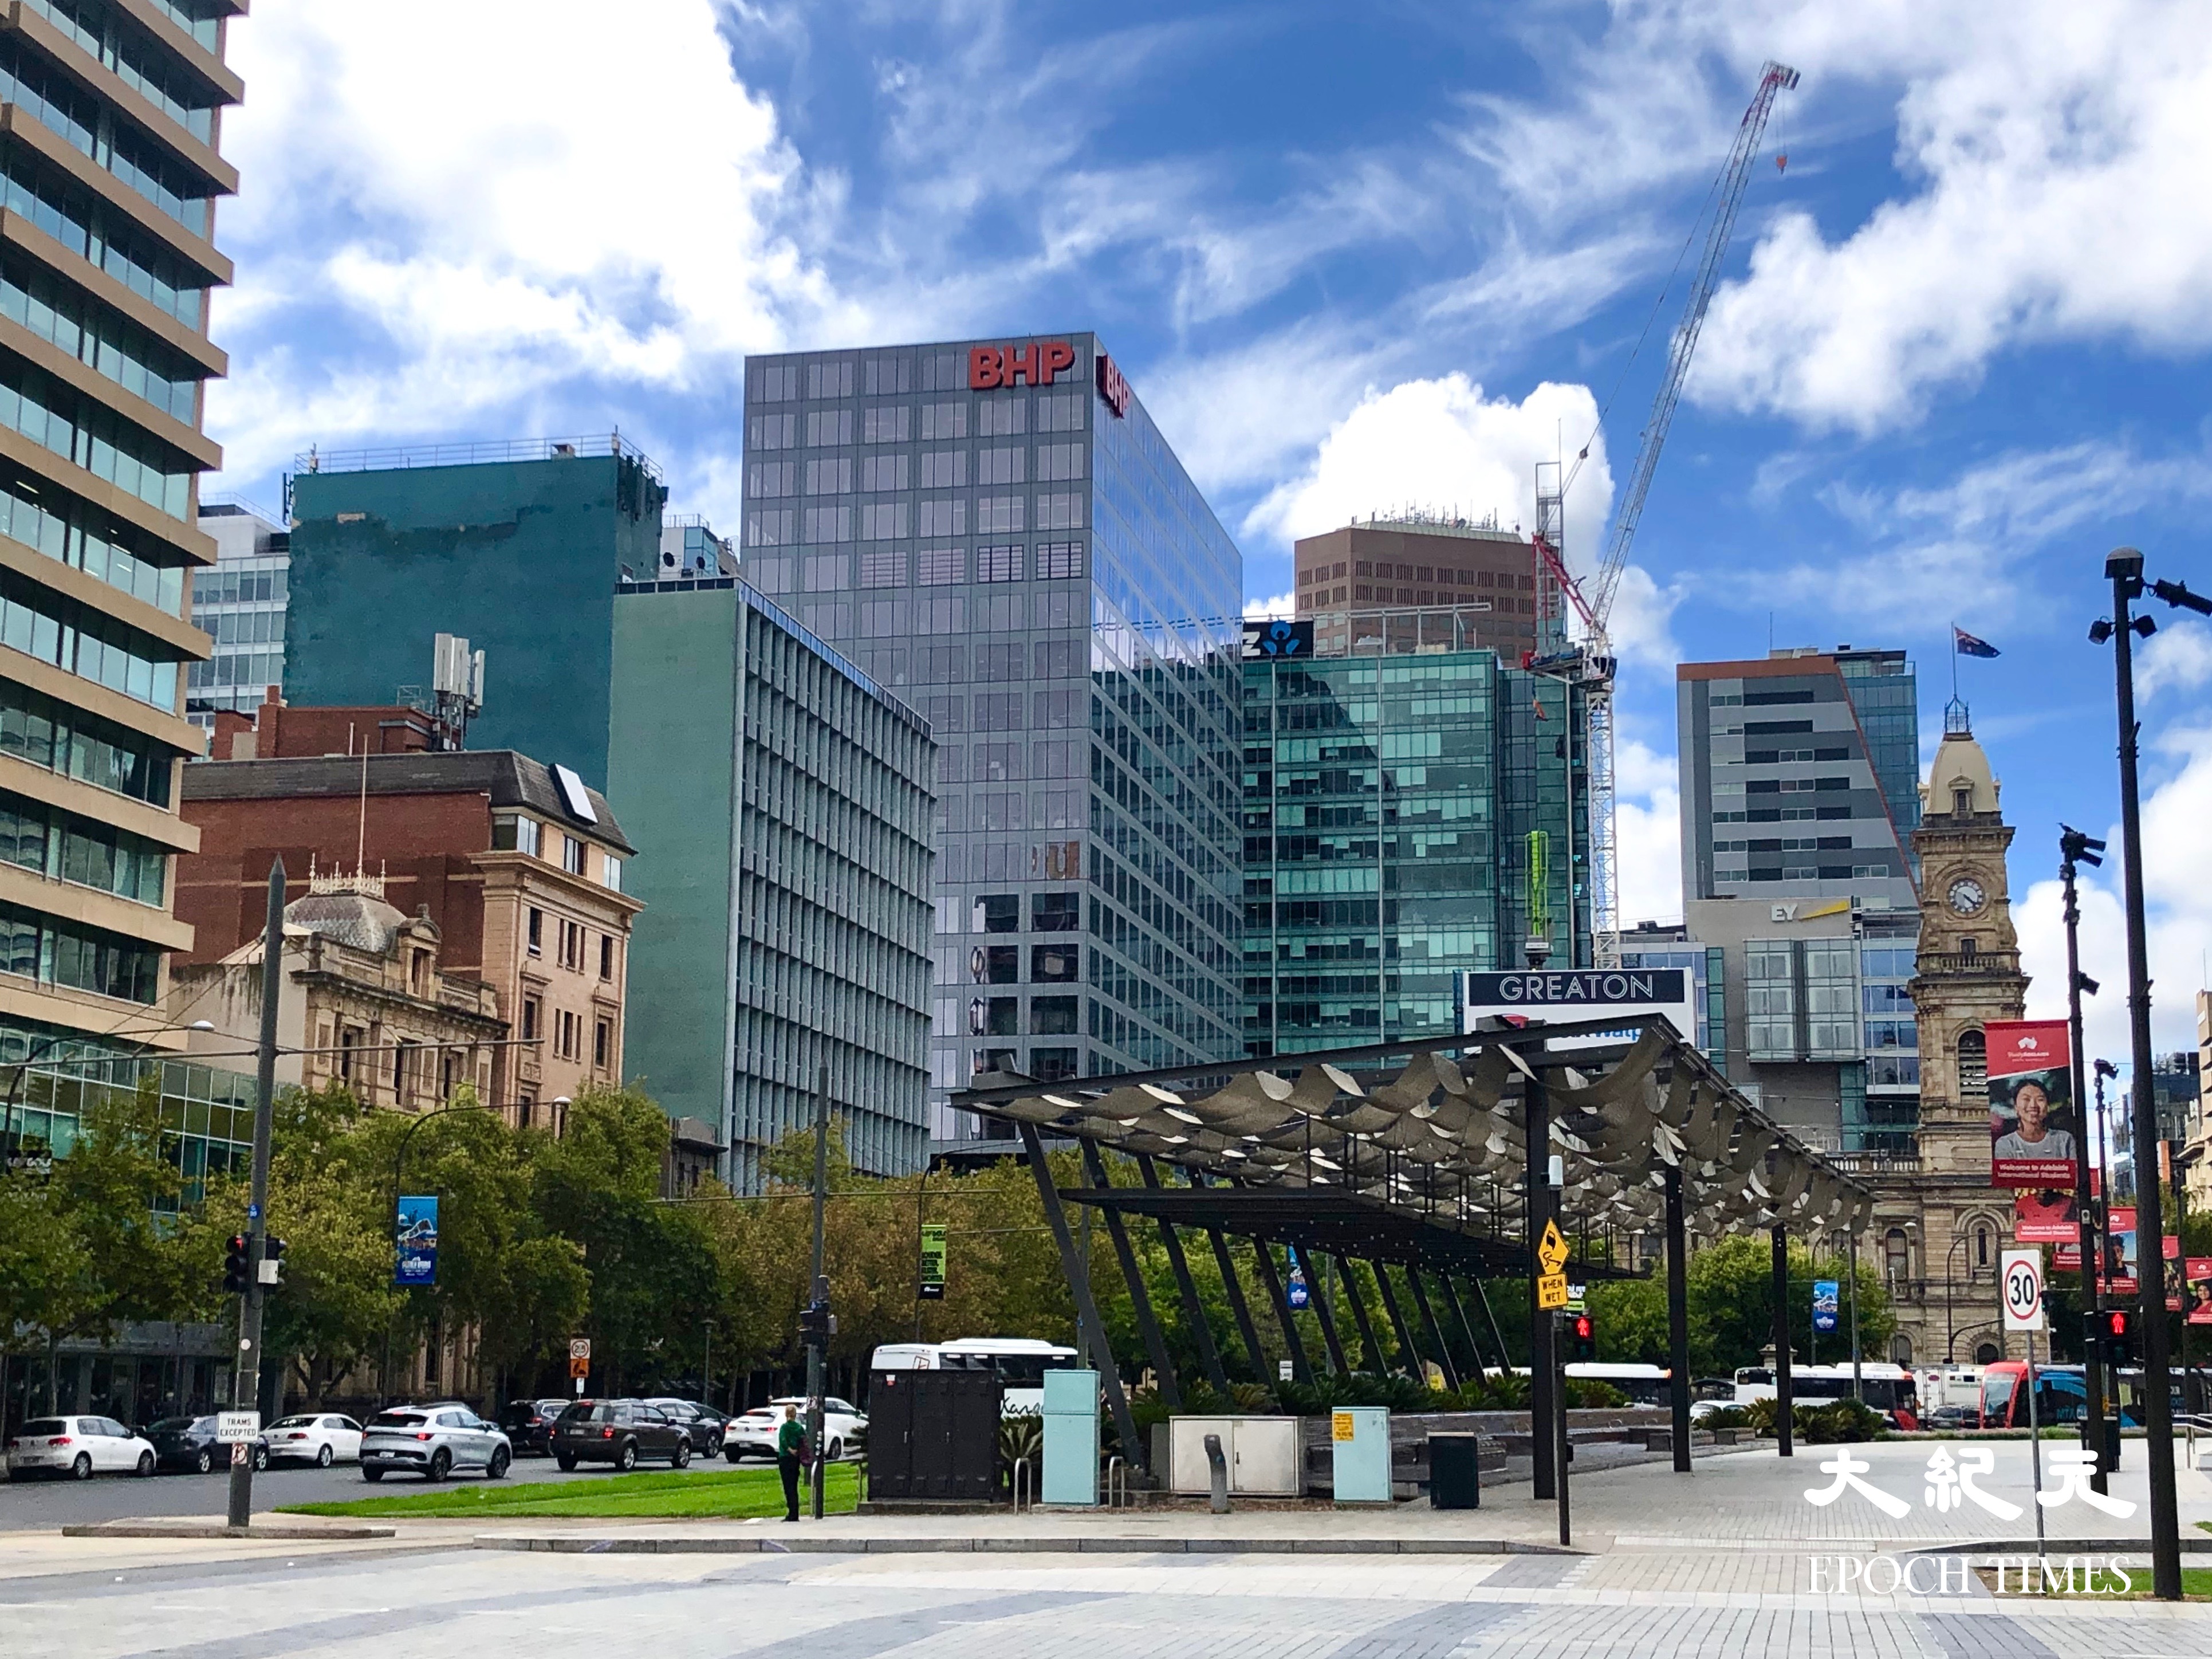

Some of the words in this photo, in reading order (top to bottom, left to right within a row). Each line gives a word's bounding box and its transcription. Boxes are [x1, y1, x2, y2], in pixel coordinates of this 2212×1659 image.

[970, 341, 1075, 390] BHP
[1100, 355, 1129, 419] BHP
[1771, 903, 1798, 922] EY
[1499, 974, 1654, 1001] GREATON
[2040, 1163, 2069, 1171] Adelaide
[1542, 1279, 1563, 1291] WHEN
[2010, 1274, 2034, 1306] 30
[1545, 1292, 1561, 1303] WET
[227, 1418, 251, 1426] TRAMS
[219, 1428, 257, 1437] EXCEPTED
